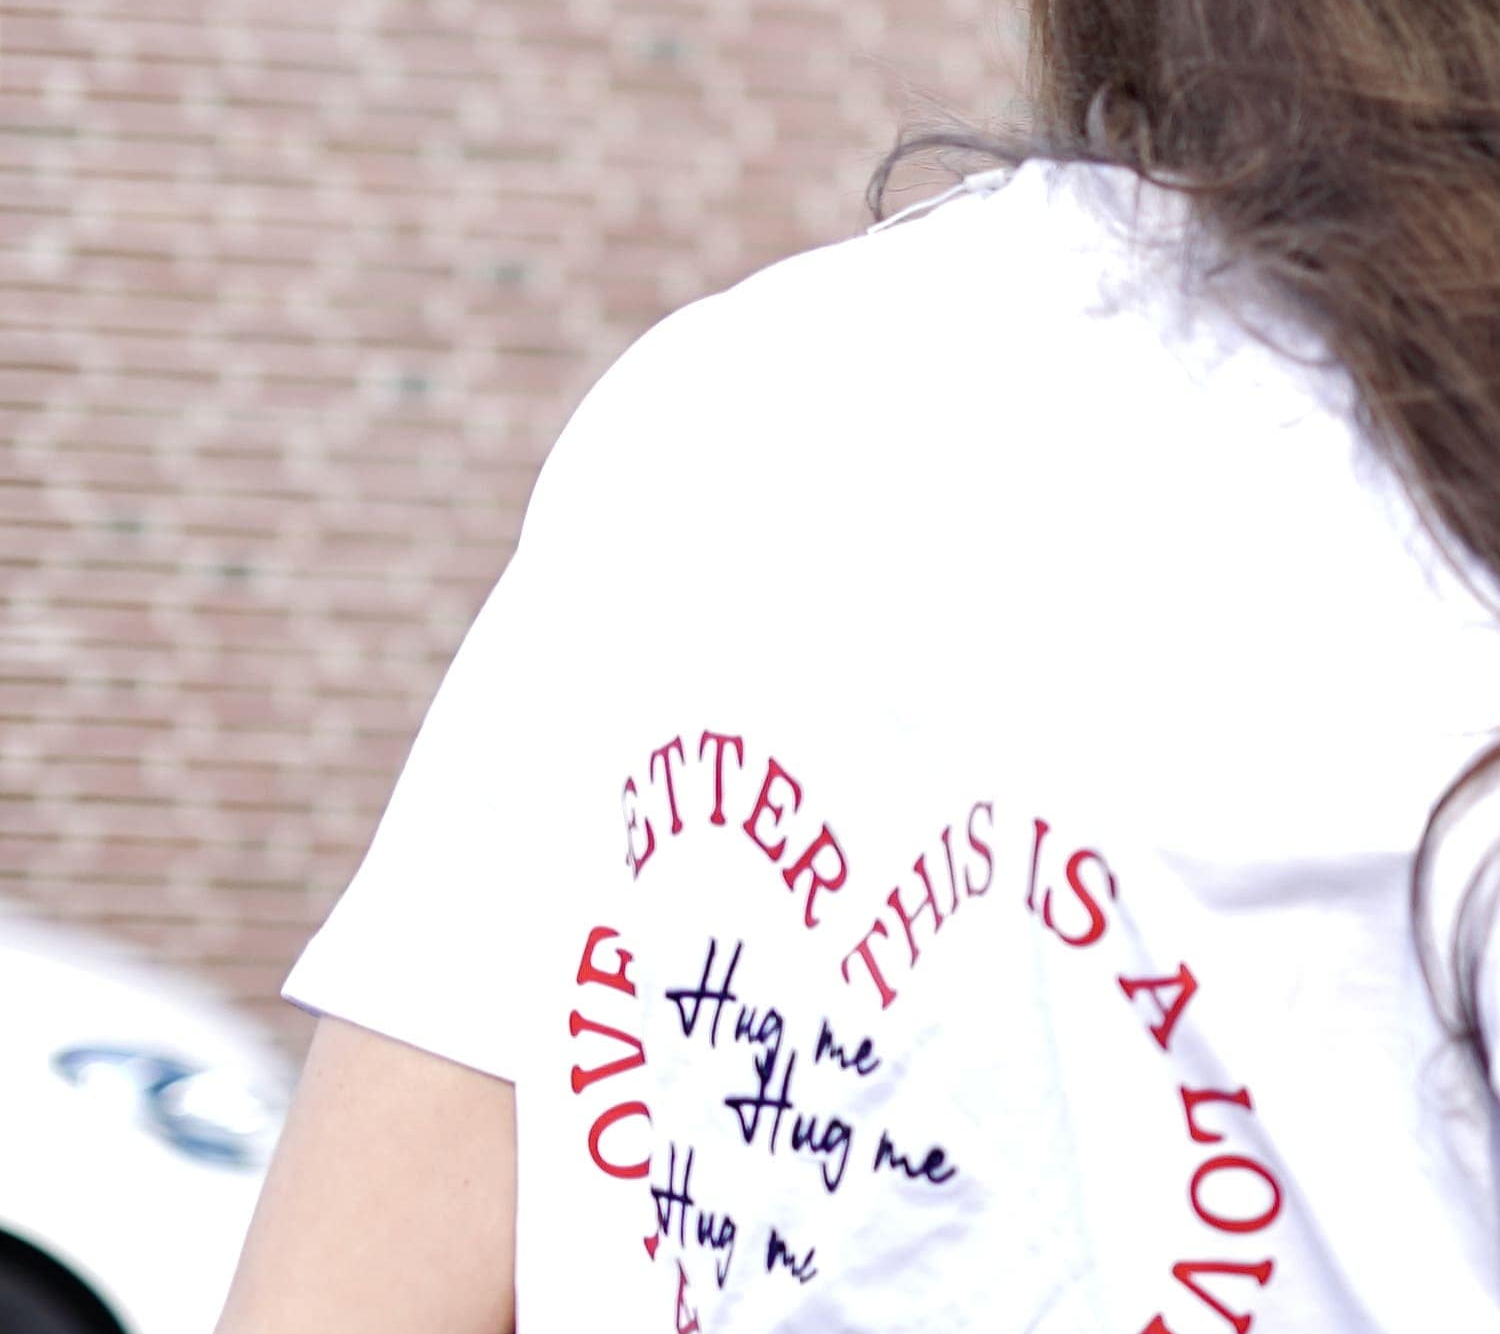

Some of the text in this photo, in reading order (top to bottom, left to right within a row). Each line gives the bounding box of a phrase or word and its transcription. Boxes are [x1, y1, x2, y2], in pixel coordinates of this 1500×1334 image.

[568, 925, 660, 1263] OVE
[622, 728, 850, 929] ETTER
[840, 800, 995, 1011] THIS
[1025, 817, 1119, 950] IS
[1116, 961, 1200, 1053] A
[666, 937, 883, 1087] Hug me
[724, 1047, 958, 1194] Hug me
[650, 1139, 738, 1291] Hug
